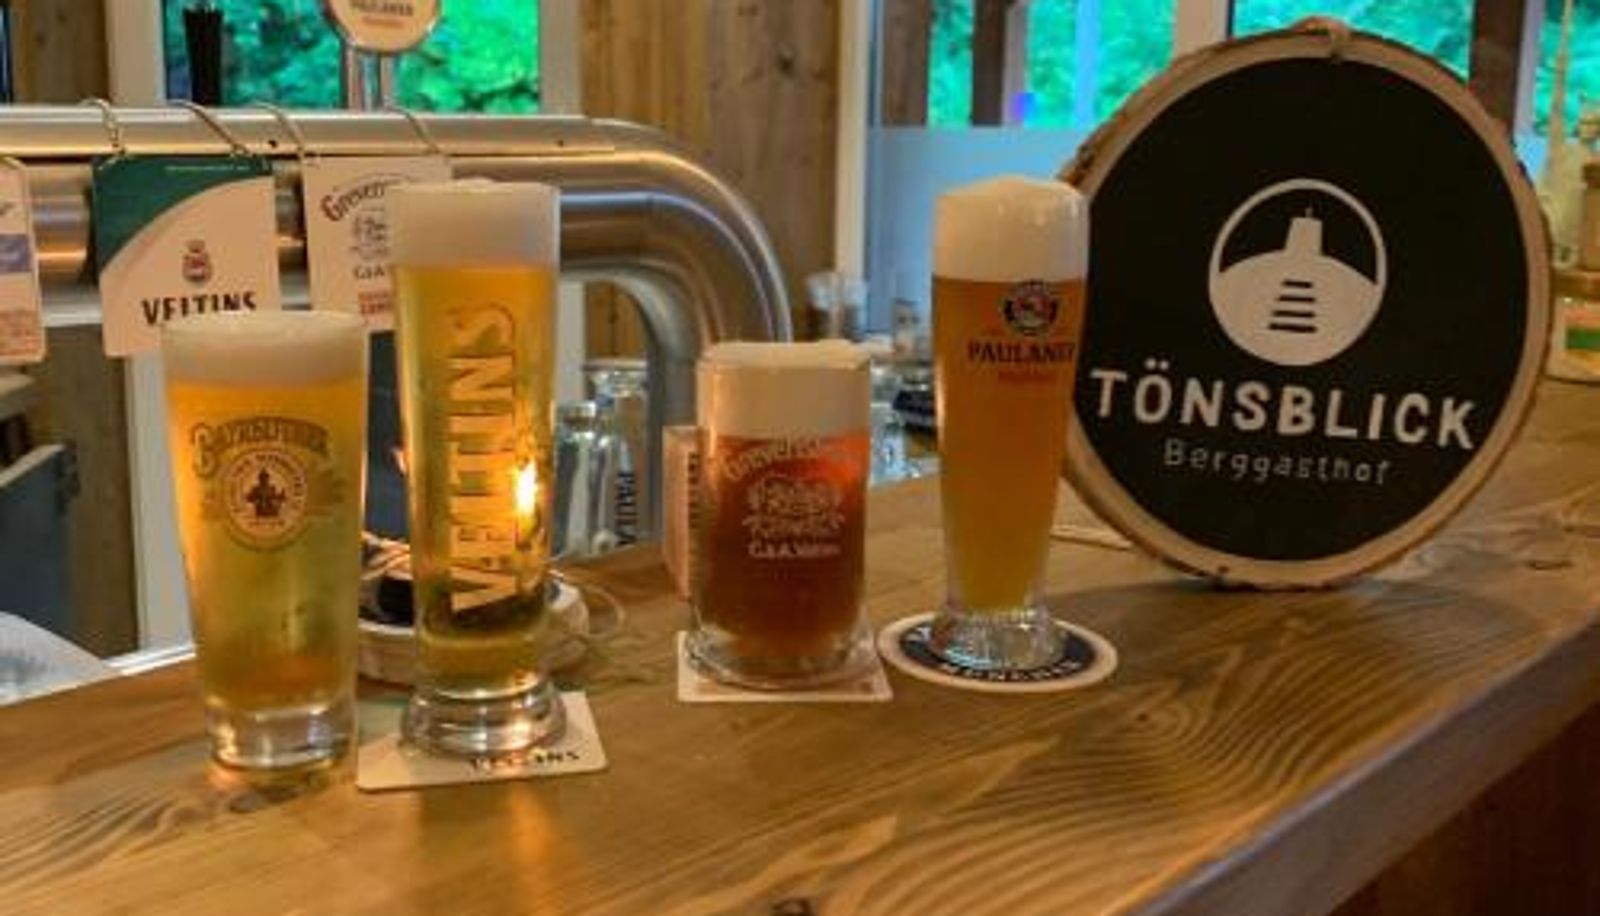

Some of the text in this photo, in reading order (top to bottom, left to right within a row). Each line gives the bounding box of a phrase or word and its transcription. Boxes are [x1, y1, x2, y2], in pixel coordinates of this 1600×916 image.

[1091, 358, 1477, 450] TÖNSBLICK
[448, 305, 516, 612] VELTINS
[1163, 438, 1393, 485] Berggasthof
